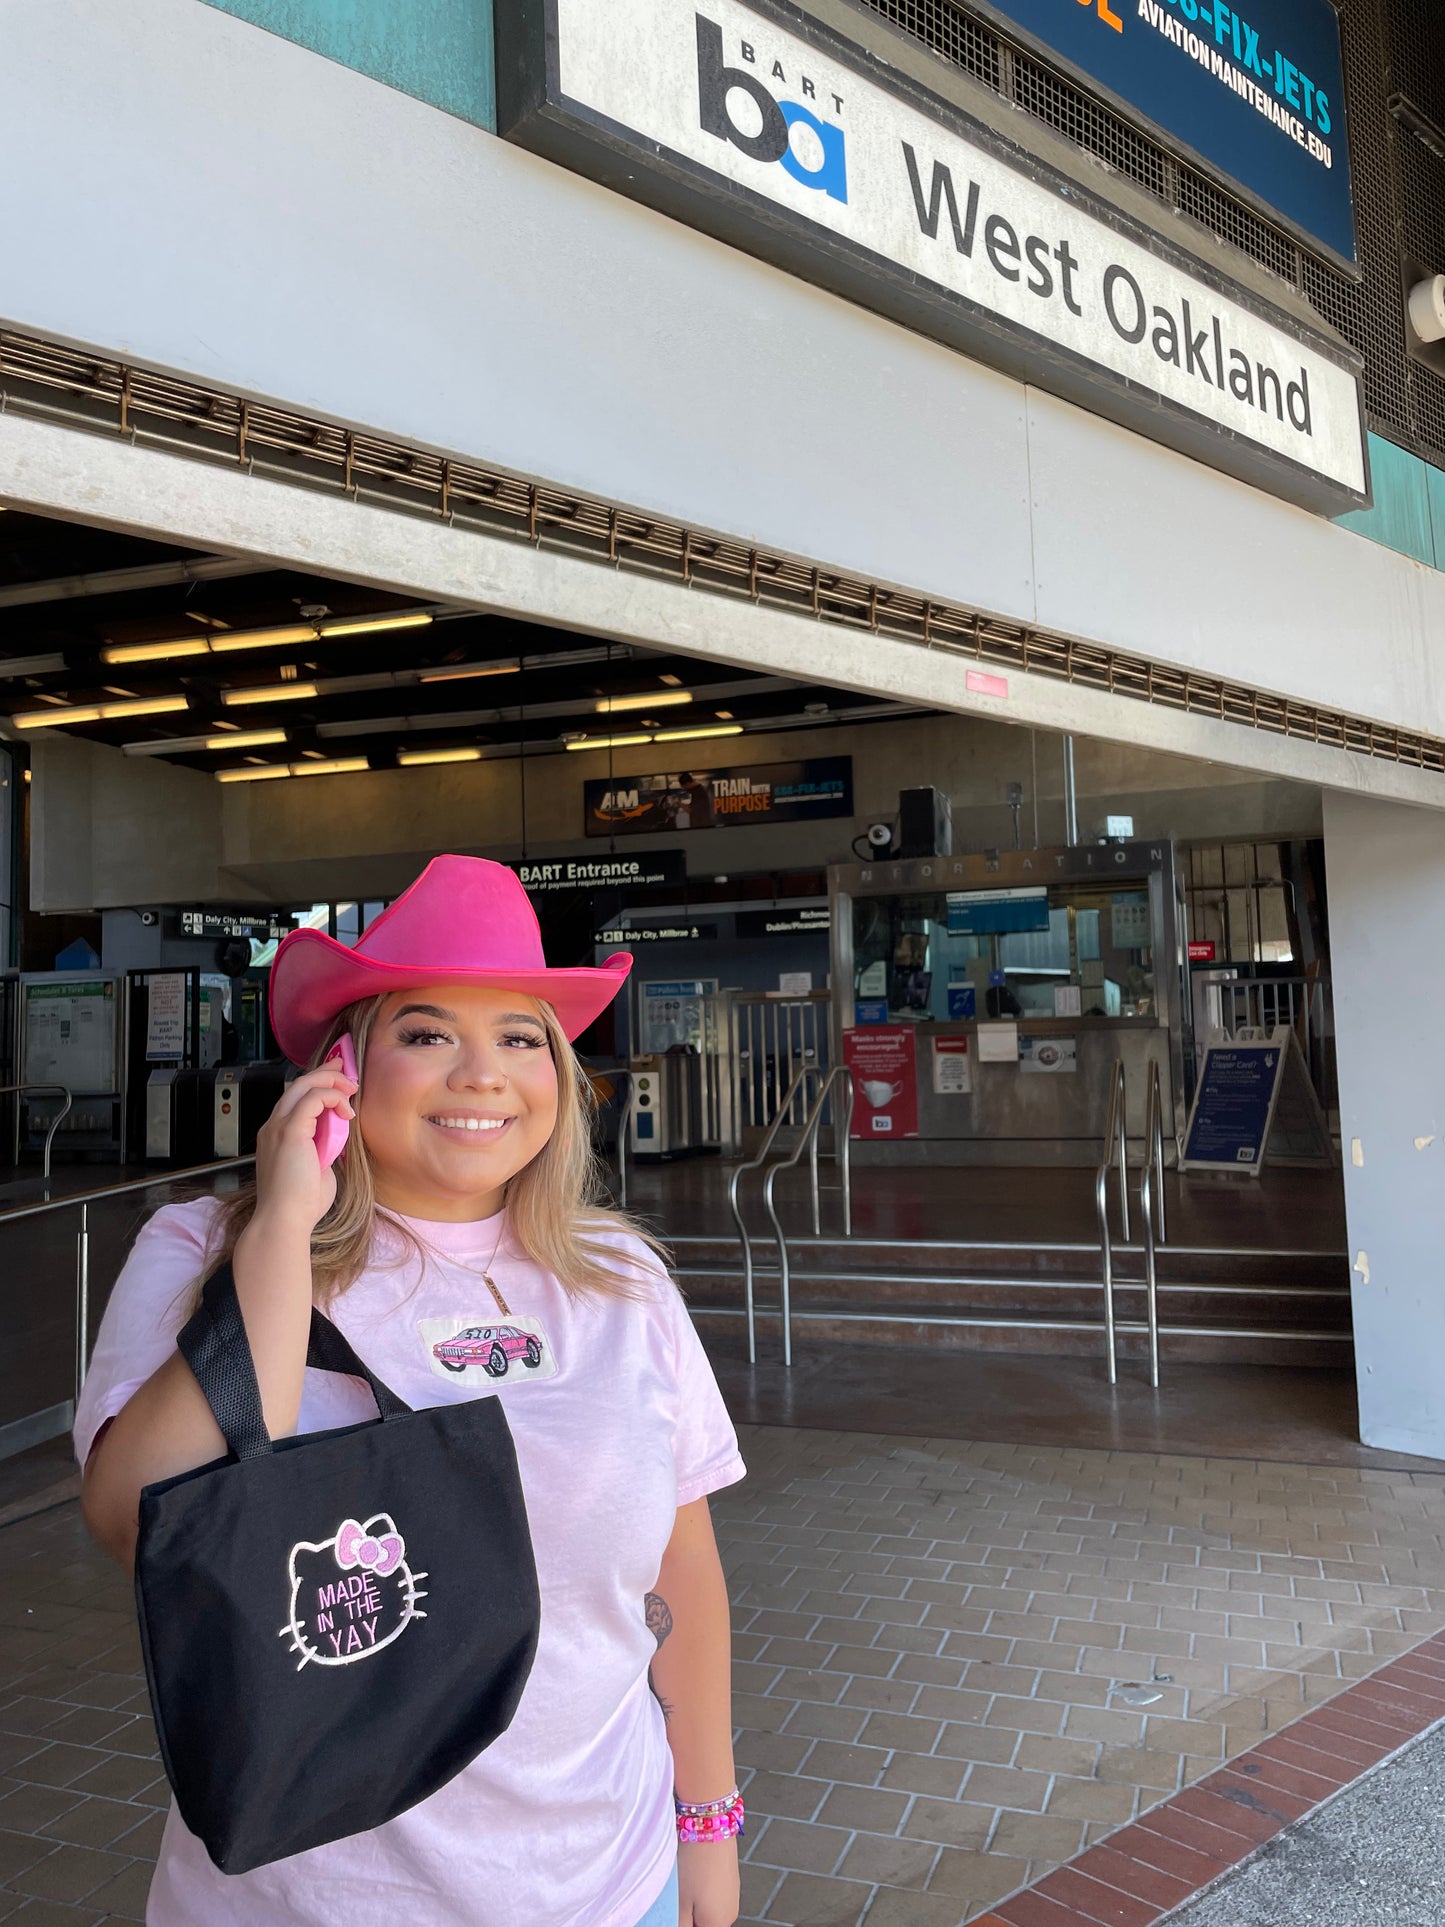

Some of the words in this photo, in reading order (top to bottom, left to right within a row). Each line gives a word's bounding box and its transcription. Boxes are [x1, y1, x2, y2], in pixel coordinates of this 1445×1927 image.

[741, 39, 844, 115] BART
[901, 140, 1082, 318] West
[1103, 264, 1313, 437] Oakland
[712, 778, 750, 797] TRAIN
[713, 794, 771, 815] PURPOSE
[520, 864, 562, 883] BART
[567, 861, 640, 880] Entrance
[548, 880, 577, 890] payment
[577, 877, 606, 888] required
[606, 875, 632, 886] beyond
[632, 874, 645, 883] this
[646, 873, 665, 883] point
[625, 930, 641, 941] Daly
[642, 929, 658, 940] City,
[659, 928, 689, 938] Millbrae
[465, 1328, 492, 1340] 510
[318, 1570, 378, 1611] MADE
[317, 1610, 335, 1634] IN
[344, 1590, 384, 1621] THE
[329, 1616, 378, 1658] YAY
